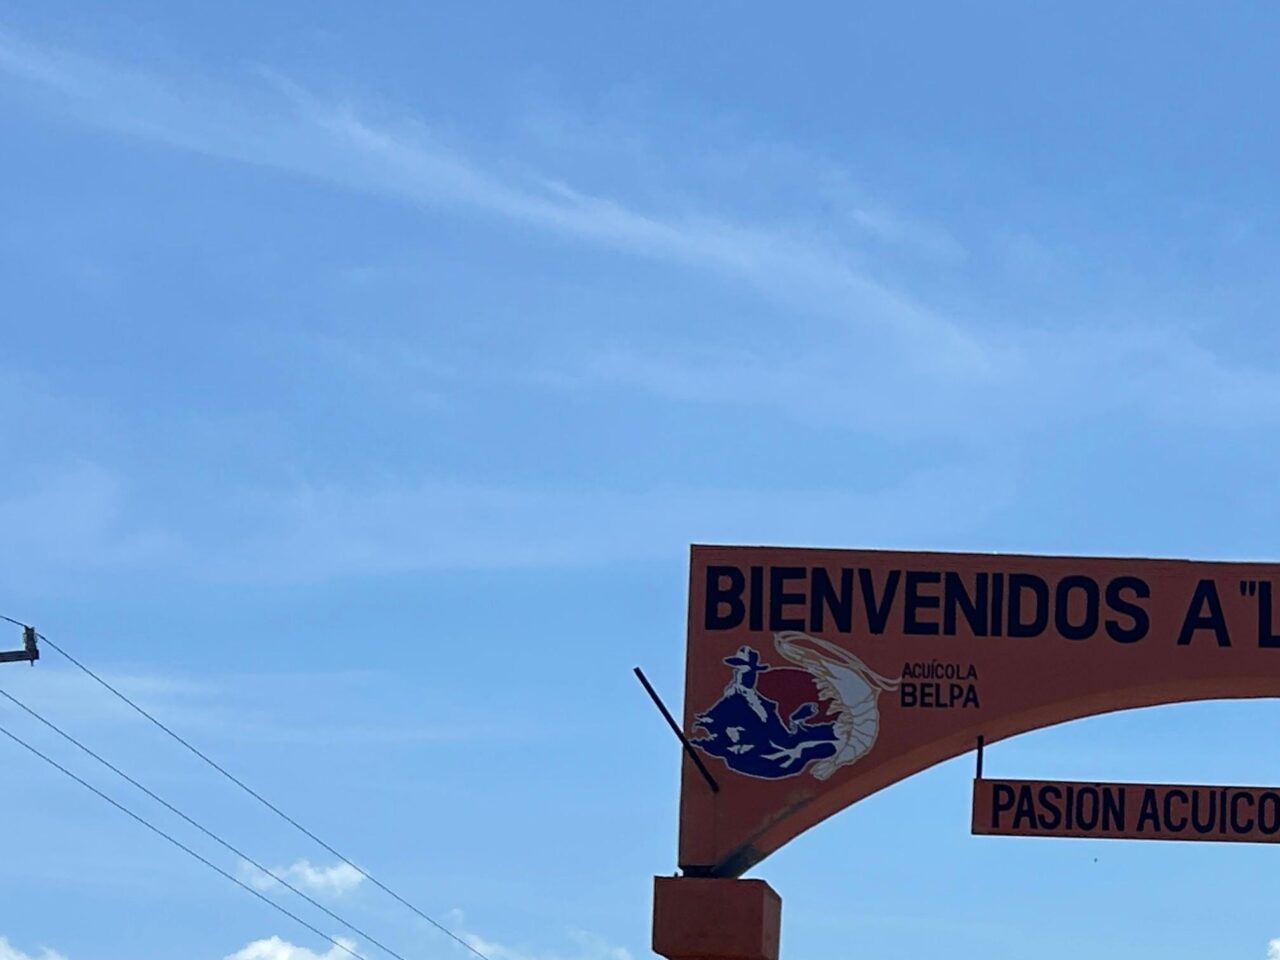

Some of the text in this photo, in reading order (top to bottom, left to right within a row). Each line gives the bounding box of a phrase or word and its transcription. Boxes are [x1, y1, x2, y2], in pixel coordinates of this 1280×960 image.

[705, 566, 1150, 643] BIENVENIDOS
[1177, 579, 1232, 647] A
[902, 659, 978, 681] ACUÍCOLA
[901, 683, 980, 708] BELPA
